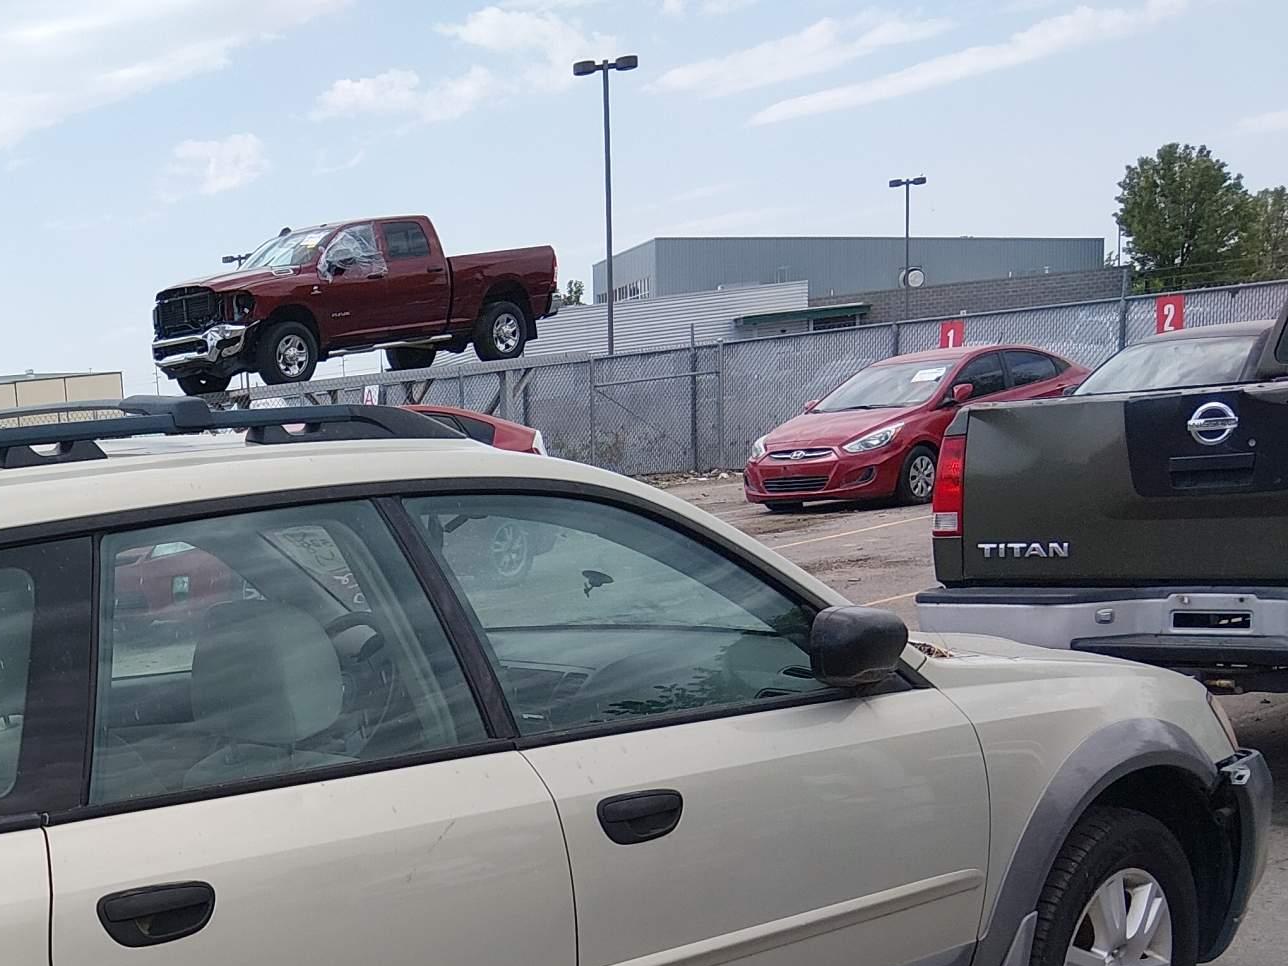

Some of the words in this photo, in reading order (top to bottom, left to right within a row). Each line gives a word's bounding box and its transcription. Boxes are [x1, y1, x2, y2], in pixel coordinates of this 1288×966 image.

[1163, 304, 1176, 331] 2
[947, 328, 955, 348] 1
[365, 388, 375, 405] A
[977, 543, 1069, 558] TITAN
